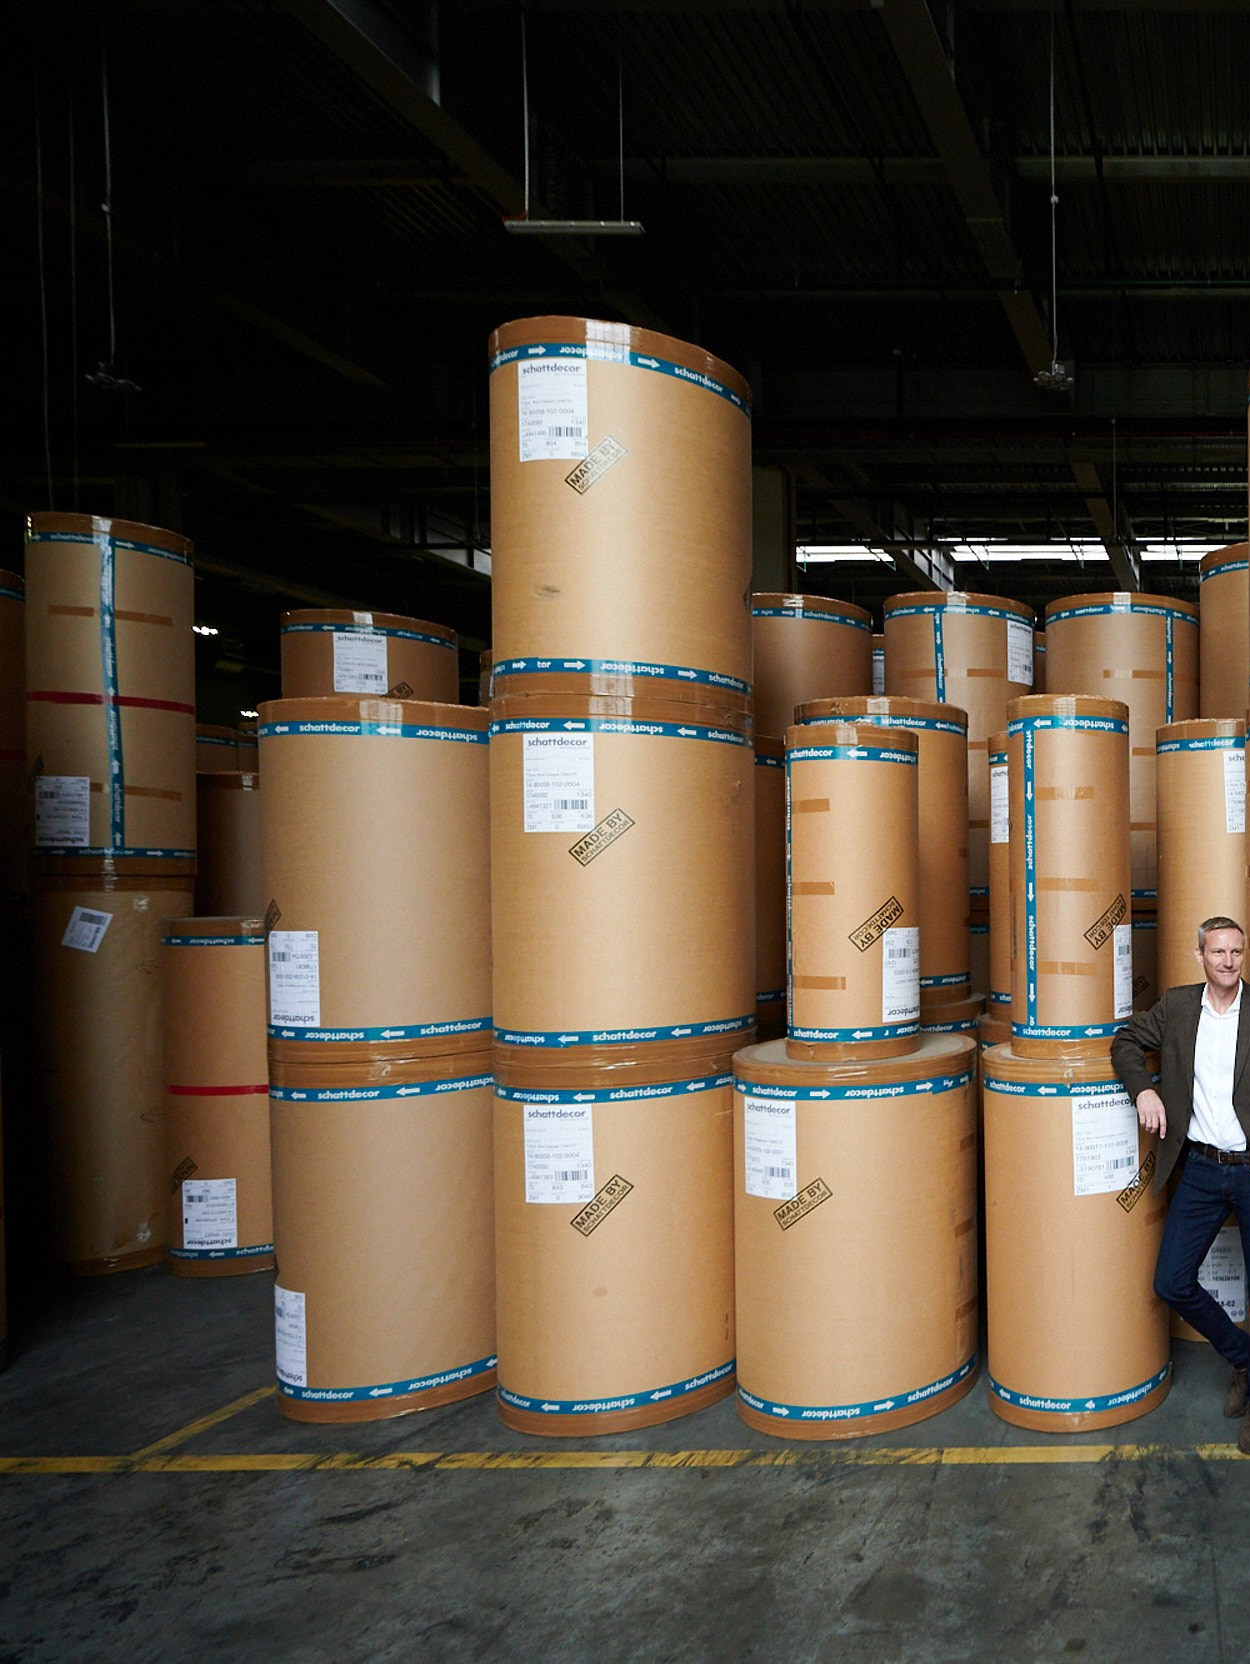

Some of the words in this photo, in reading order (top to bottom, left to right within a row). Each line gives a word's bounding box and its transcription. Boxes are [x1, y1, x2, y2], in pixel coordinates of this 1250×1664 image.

[522, 363, 581, 374] schattdecor
[674, 365, 723, 392] schattdecor
[570, 453, 600, 487] MADE
[600, 439, 618, 456] BY
[601, 663, 665, 674] schattdecor
[299, 723, 360, 732] schattdecor
[505, 720, 550, 730] schattdecor
[599, 722, 663, 734] schattdecor
[1064, 720, 1114, 731] schattdecor
[416, 729, 478, 742] schattdecor
[527, 737, 588, 747] schattdecor
[789, 749, 833, 759] schattdecor
[574, 827, 603, 857] MADE
[605, 813, 623, 828] BY
[581, 819, 631, 862] SCHATTDECOR
[852, 901, 896, 940] SCHATTDECOR
[875, 907, 901, 934] MADE
[1107, 904, 1126, 932] MADE
[860, 933, 875, 948] BY
[1095, 930, 1107, 945] BY
[273, 1012, 315, 1025] schattdecor
[420, 1022, 482, 1035] schattdecor
[793, 1030, 839, 1040] schattdecor
[1022, 1028, 1071, 1037] schattdecor
[305, 1031, 364, 1041] schattdecor
[593, 1030, 657, 1041] schattdecor
[435, 1076, 494, 1091] schattdecor
[989, 1082, 1025, 1093] schattdecor
[1070, 1084, 1124, 1095] schattdecor
[318, 1090, 380, 1099] schattdecor
[513, 1091, 559, 1102] schattdecor
[610, 1085, 673, 1099] schattdecor
[752, 1086, 797, 1097] schattdecor
[845, 1086, 904, 1099] schattdecor
[528, 1109, 586, 1119] schattdecor
[747, 1103, 790, 1115] schattdecor
[574, 1195, 605, 1229] MADE
[606, 1179, 622, 1196] BY
[777, 1195, 807, 1220] MADE
[807, 1183, 823, 1197] BY
[783, 1190, 828, 1226] SCHATTDECOR
[584, 1185, 629, 1232] SCHATTDECOR
[408, 1367, 472, 1391] schattdecor
[685, 1364, 733, 1391] schattdecor
[302, 1390, 354, 1399] schattdecor
[907, 1378, 954, 1403] schattdecor
[1107, 1382, 1152, 1406] schattdecor
[573, 1398, 635, 1413] schattdecor
[1019, 1397, 1072, 1410] schattdecor
[801, 1408, 860, 1420] schattdecor
